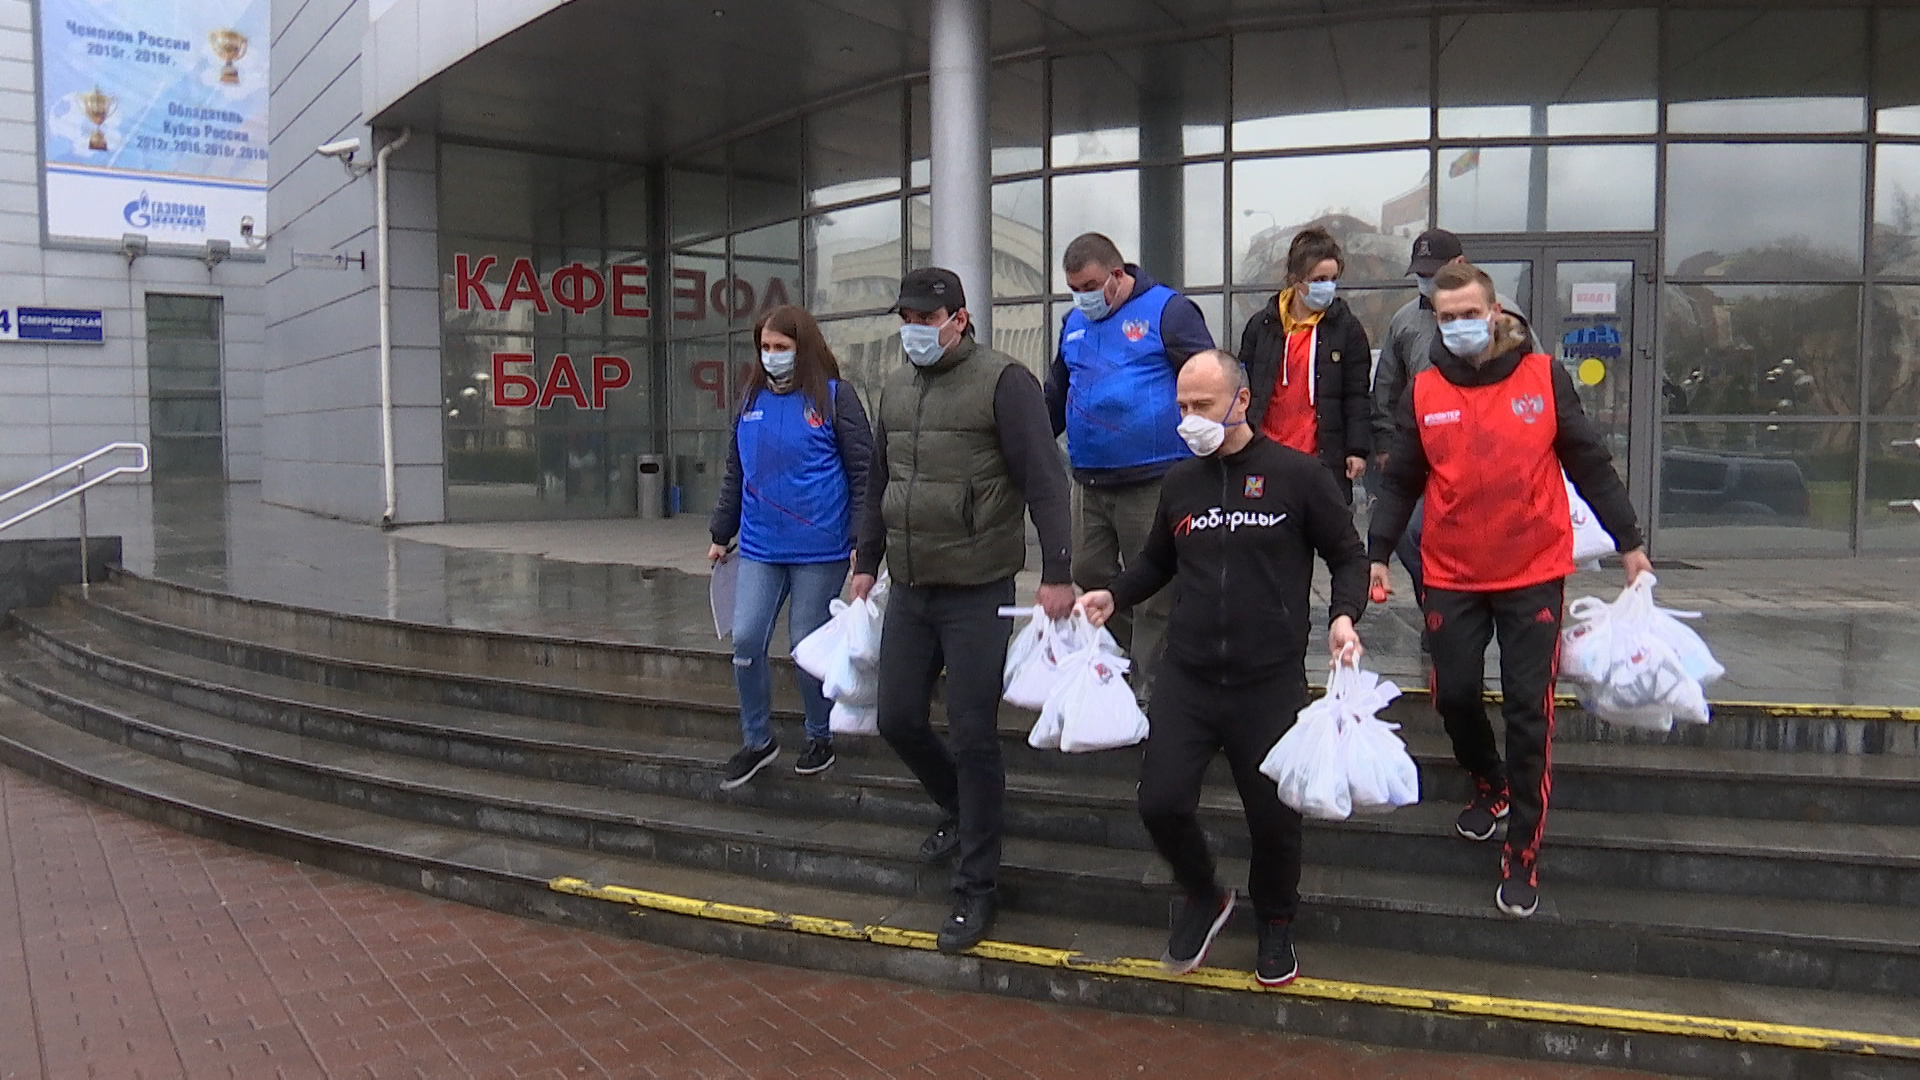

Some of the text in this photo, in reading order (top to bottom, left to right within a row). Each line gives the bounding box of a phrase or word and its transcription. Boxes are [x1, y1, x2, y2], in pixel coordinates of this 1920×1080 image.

[66, 19, 191, 52] Чемпион России
[168, 101, 243, 124] Обладатель
[163, 119, 249, 142] Кубка России
[151, 201, 206, 217] ГАЗПРОМ
[454, 253, 650, 319] КАФЕ
[20, 315, 101, 328] СМИРНОВСКАЯ
[491, 351, 632, 410] БАР
[1174, 507, 1287, 537] Люберцы
